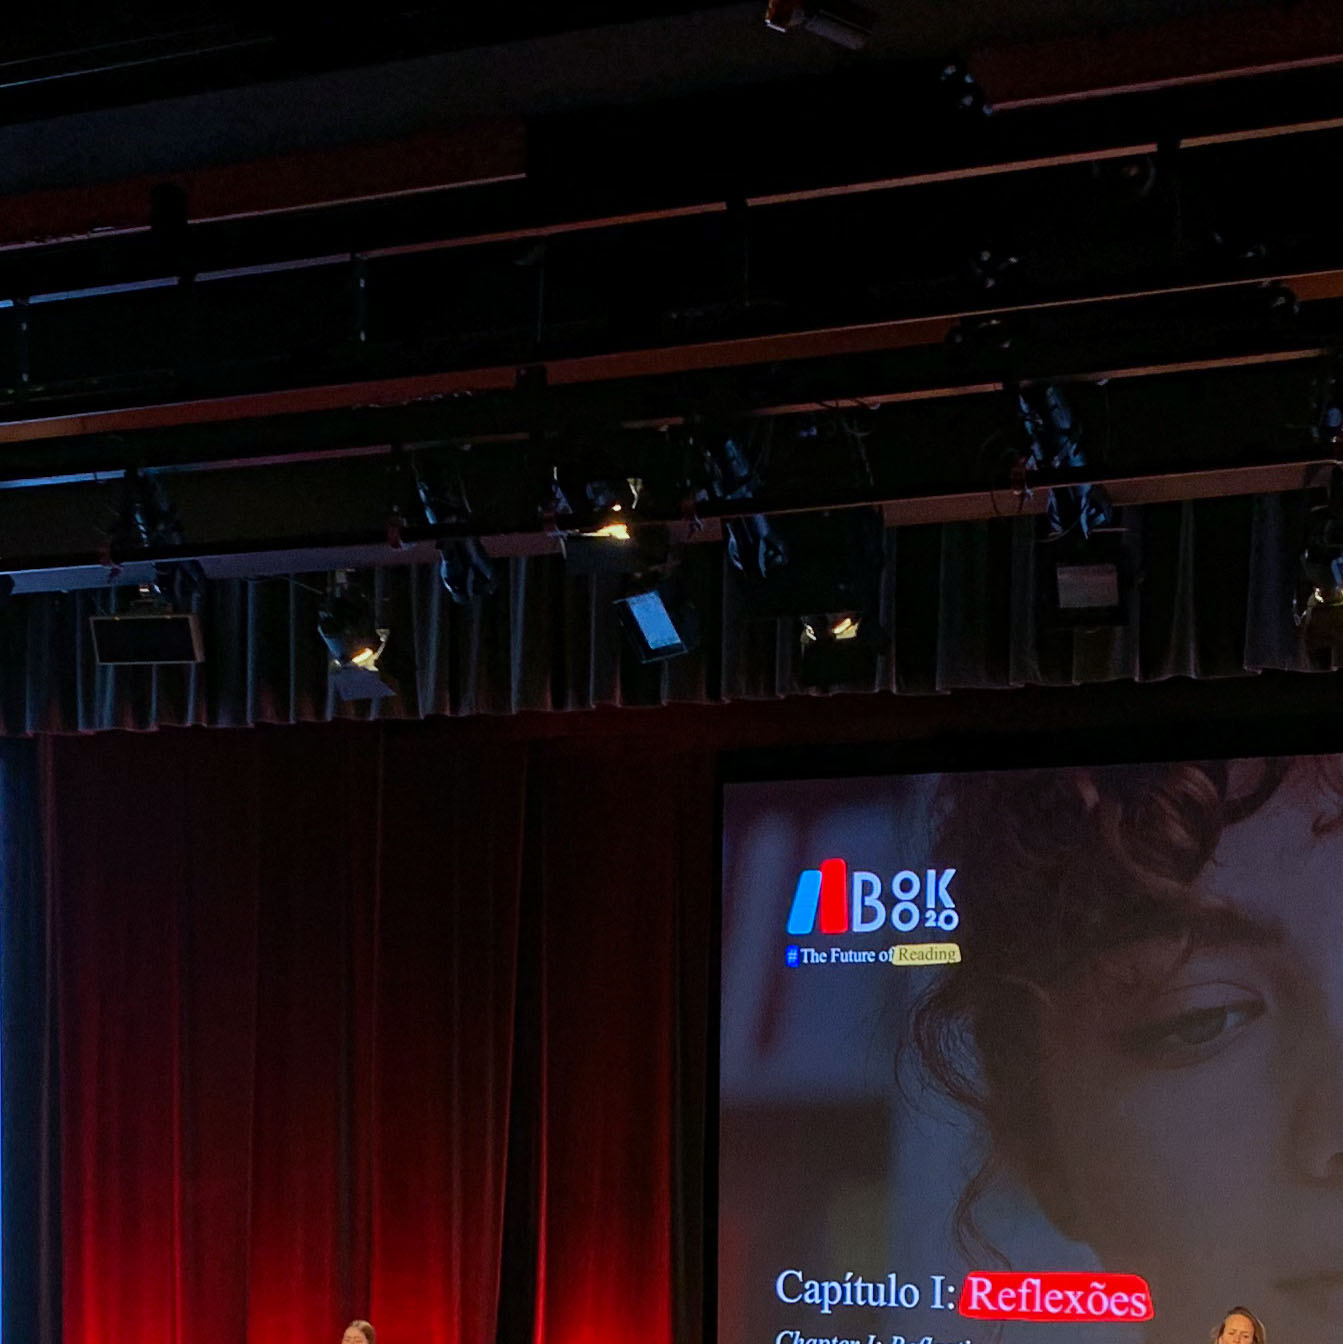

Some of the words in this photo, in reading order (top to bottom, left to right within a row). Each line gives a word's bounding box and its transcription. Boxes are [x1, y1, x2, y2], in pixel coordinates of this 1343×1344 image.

[830, 948, 875, 963] Future
[878, 946, 895, 963] of
[898, 945, 956, 963] Reading
[776, 1269, 920, 1314] Capítulo
[930, 1275, 955, 1310] I:
[968, 1276, 1147, 1318] Reflexões
